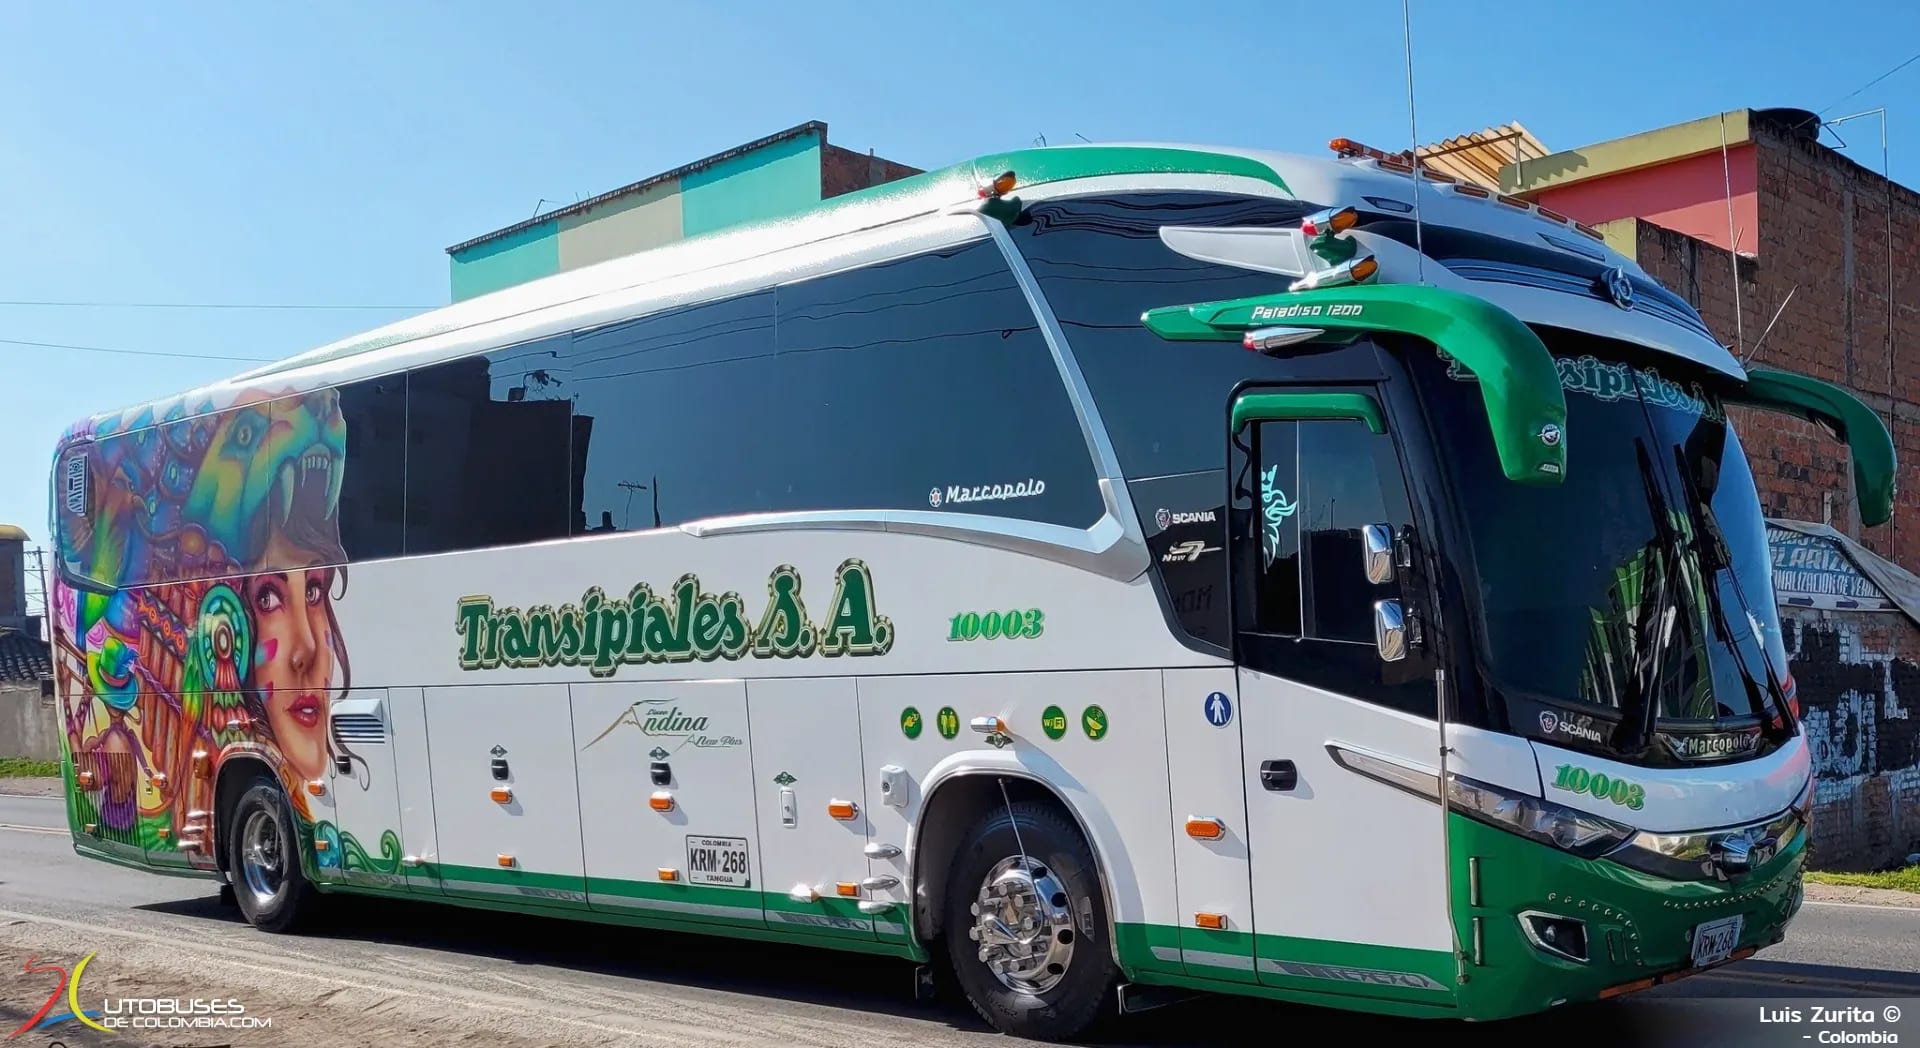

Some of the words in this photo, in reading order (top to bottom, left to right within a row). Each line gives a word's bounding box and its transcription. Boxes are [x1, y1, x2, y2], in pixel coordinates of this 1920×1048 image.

[1251, 303, 1323, 320] Paradiso
[1326, 304, 1363, 316] 1200
[945, 478, 1045, 503] Marcopolo
[1172, 511, 1216, 524] SCANIA
[456, 572, 754, 678] Transipiales
[752, 564, 817, 658] S.
[817, 557, 896, 657] A.
[946, 608, 1045, 642] 10003
[1559, 721, 1602, 744] SCANIA
[1688, 734, 1750, 754] Marcopolo
[1551, 763, 1647, 812] 10003
[701, 839, 732, 847] COLOMBIA
